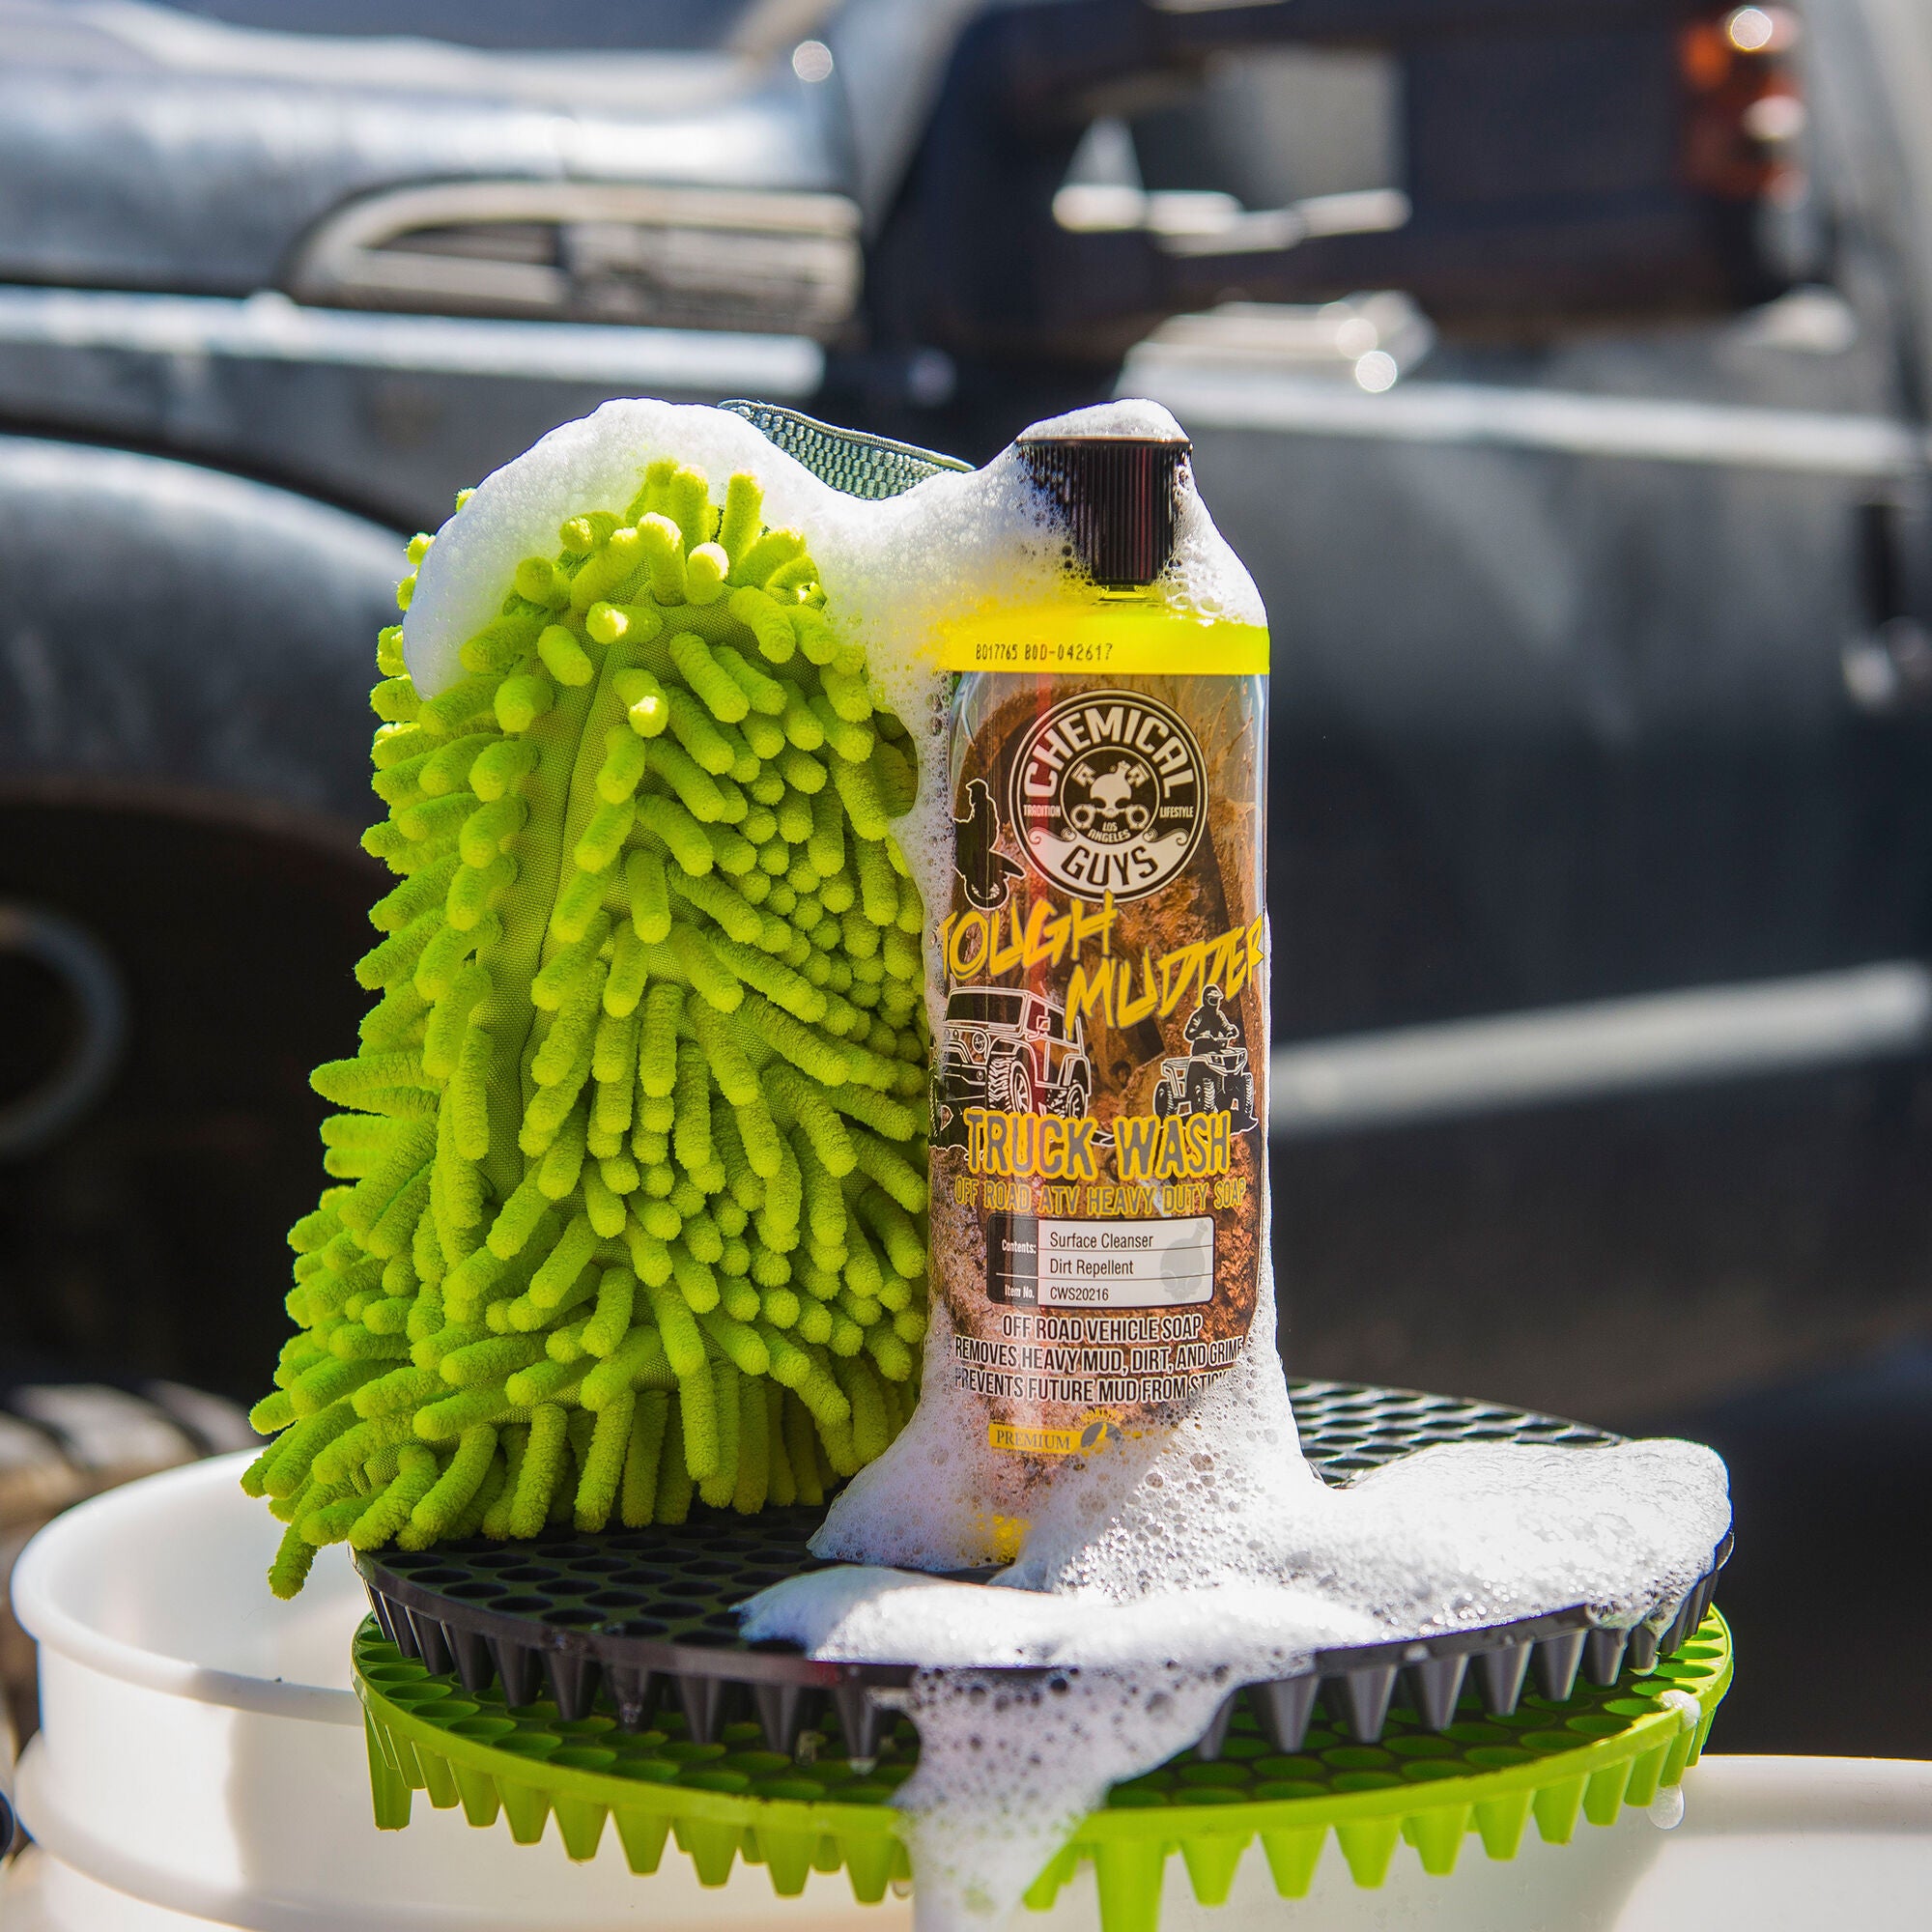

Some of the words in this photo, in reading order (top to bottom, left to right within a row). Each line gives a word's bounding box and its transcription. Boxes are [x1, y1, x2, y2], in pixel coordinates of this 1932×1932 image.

[1023, 706, 1195, 798] CHEMICAL
[1023, 804, 1062, 818] TRADITION
[1159, 805, 1195, 818] LIFESTYLE
[1087, 828, 1131, 844] ANGELES
[1101, 821, 1119, 832] LOS
[1060, 844, 1159, 887] GUYS
[940, 889, 1118, 980] TOUGH
[1064, 914, 1265, 1042] MUDDER
[964, 1108, 1098, 1180] TRUCK
[1112, 1109, 1233, 1180] WASH
[953, 1176, 979, 1207] OFF
[983, 1180, 1032, 1211] ROAD
[1038, 1184, 1081, 1215] ATV
[1086, 1184, 1157, 1216] HEAVY
[1162, 1181, 1209, 1214] DUTY
[1214, 1177, 1247, 1209] SOAP
[1001, 1238, 1037, 1255] Contents:
[1050, 1232, 1097, 1248] Surface
[1101, 1233, 1154, 1249] Cleanser
[1050, 1258, 1072, 1274] Dirt
[1077, 1259, 1134, 1278] Repellent
[1004, 1284, 1021, 1298] Item
[1023, 1286, 1036, 1299] No.
[1050, 1286, 1110, 1301] CWS20216
[1003, 1314, 1032, 1338] OFF
[1036, 1318, 1083, 1342] ROAD
[1086, 1319, 1159, 1342] VEHICLE
[1162, 1315, 1202, 1340] SOAP
[955, 1336, 1017, 1368] REMOVES
[1021, 1346, 1082, 1372] HEAVY
[1083, 1350, 1128, 1375] MUD,
[1133, 1348, 1174, 1373] DIRT,
[1177, 1343, 1207, 1369] AND
[954, 1367, 1024, 1399] PREVENTS
[1029, 1378, 1094, 1402] FUTURE
[1098, 1379, 1138, 1403] MUD
[1142, 1377, 1186, 1403] FROM
[997, 1429, 1070, 1450] PREMIUM
